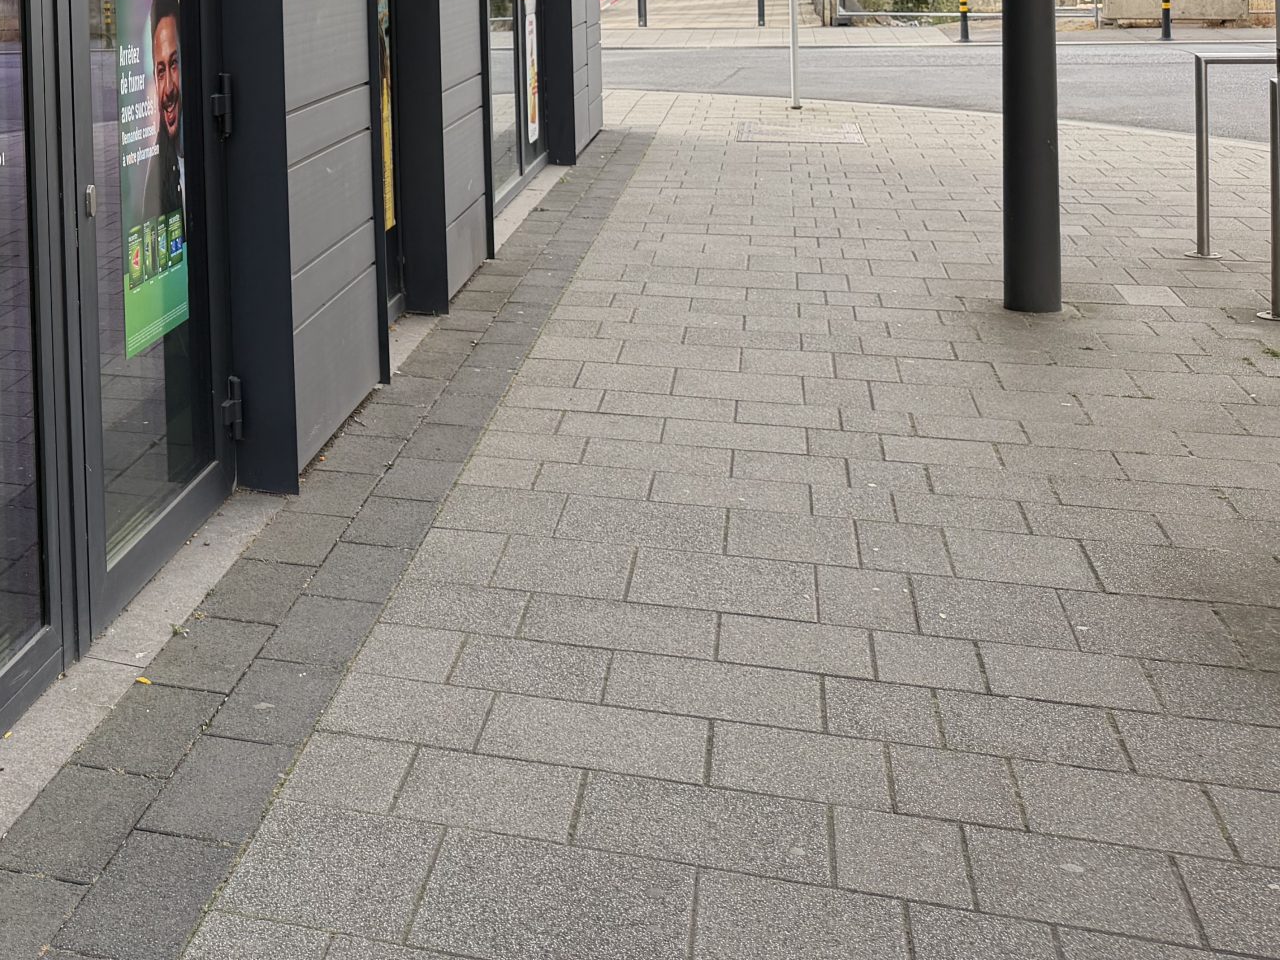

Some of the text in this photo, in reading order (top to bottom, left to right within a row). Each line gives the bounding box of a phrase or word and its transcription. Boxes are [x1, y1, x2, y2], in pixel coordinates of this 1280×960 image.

[120, 44, 140, 66] Arrêtez
[121, 71, 145, 95] de fumer
[122, 96, 154, 124] avec succès
